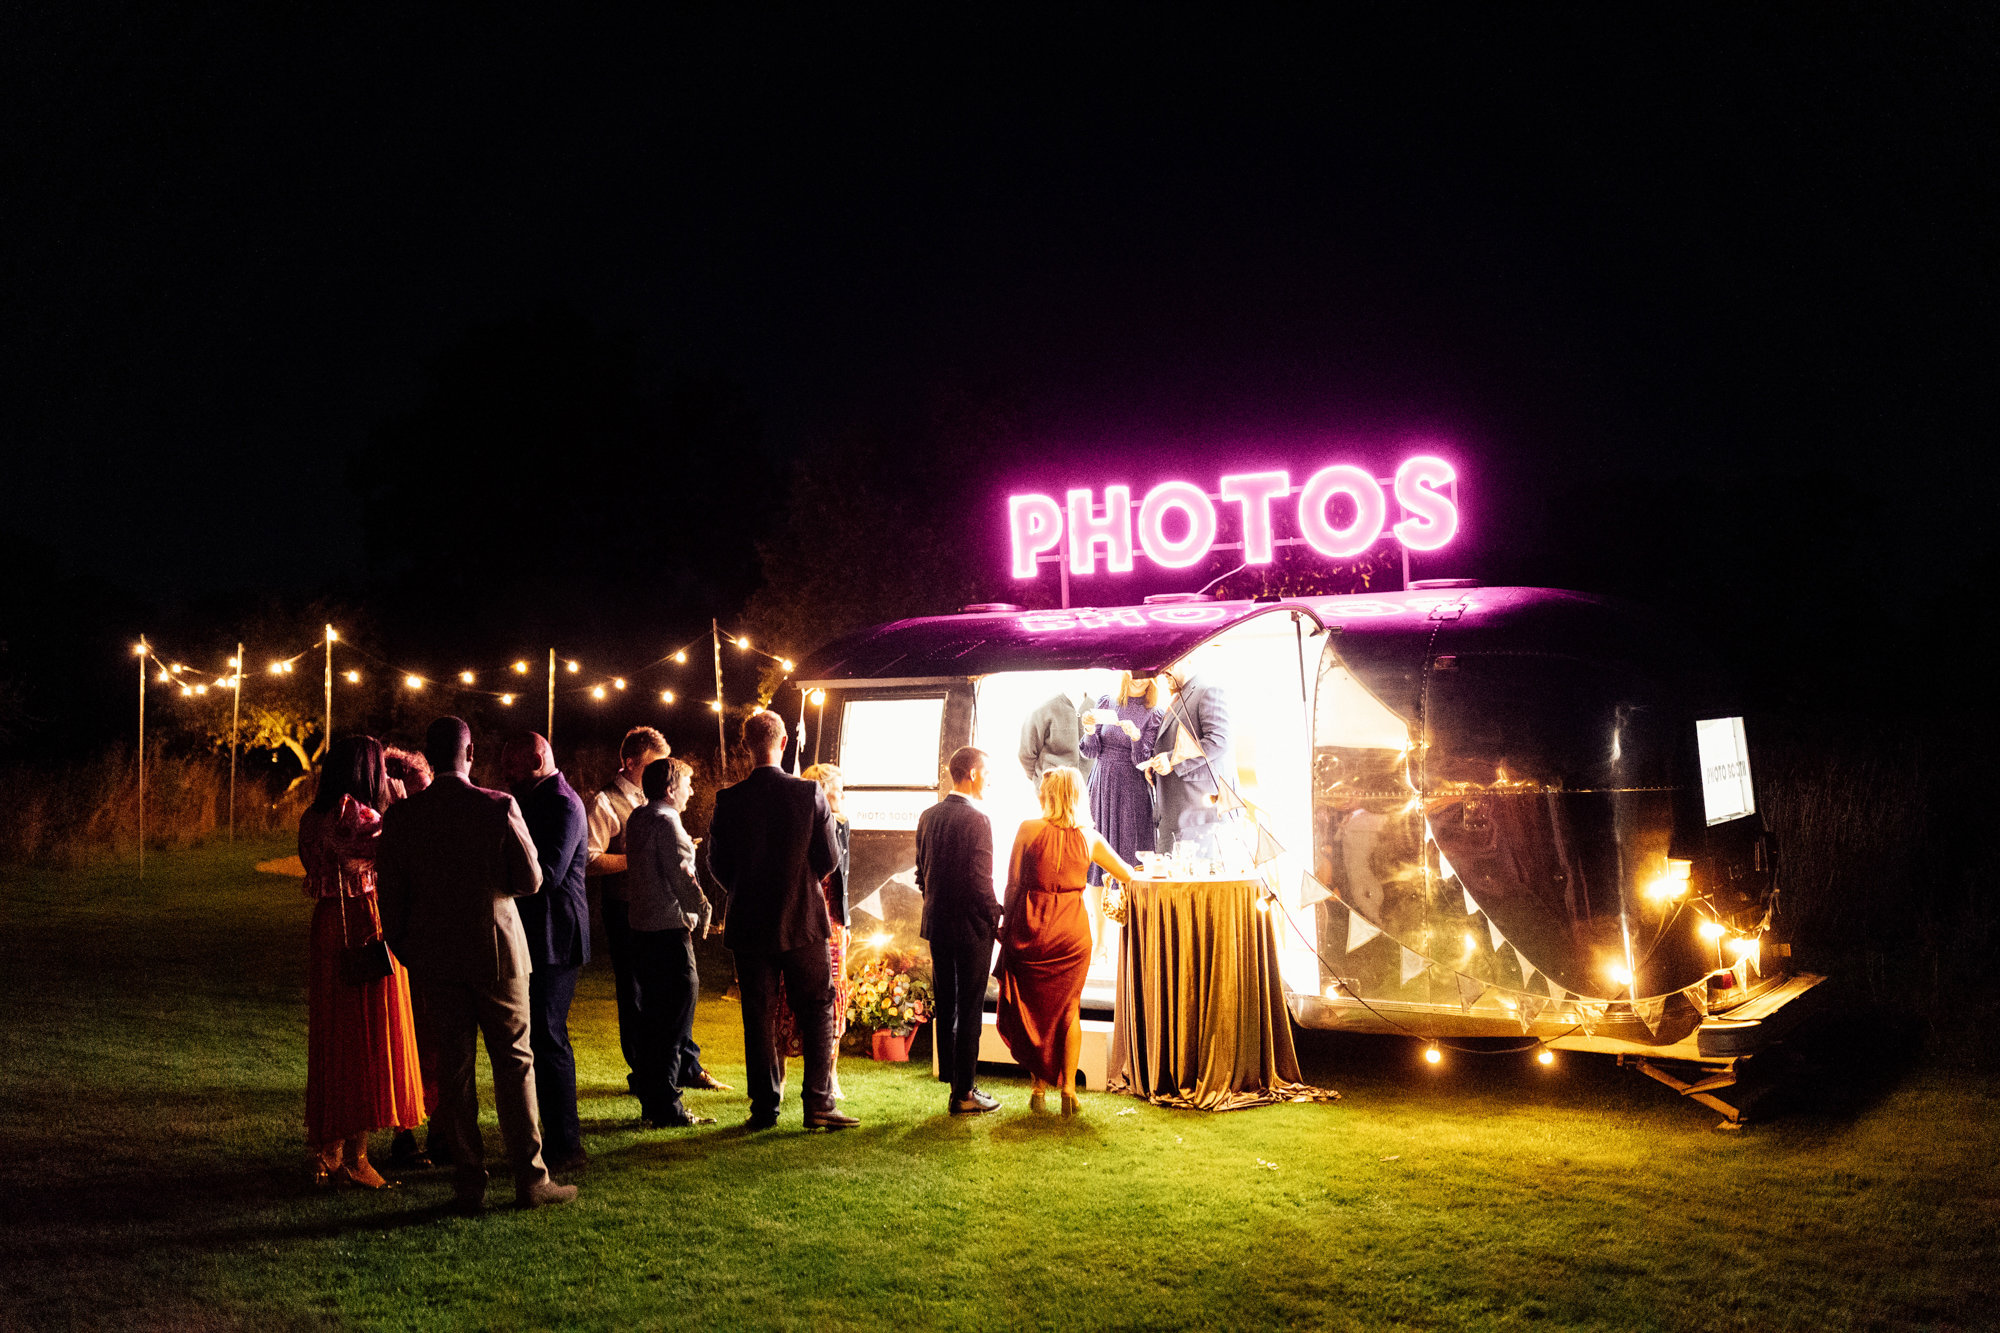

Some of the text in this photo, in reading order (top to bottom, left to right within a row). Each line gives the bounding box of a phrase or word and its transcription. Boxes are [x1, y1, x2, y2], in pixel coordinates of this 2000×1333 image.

[1008, 455, 1458, 579] PHOTOS
[1706, 764, 1726, 784] PHOTO
[856, 811, 919, 821] PHOTO BOOTH
